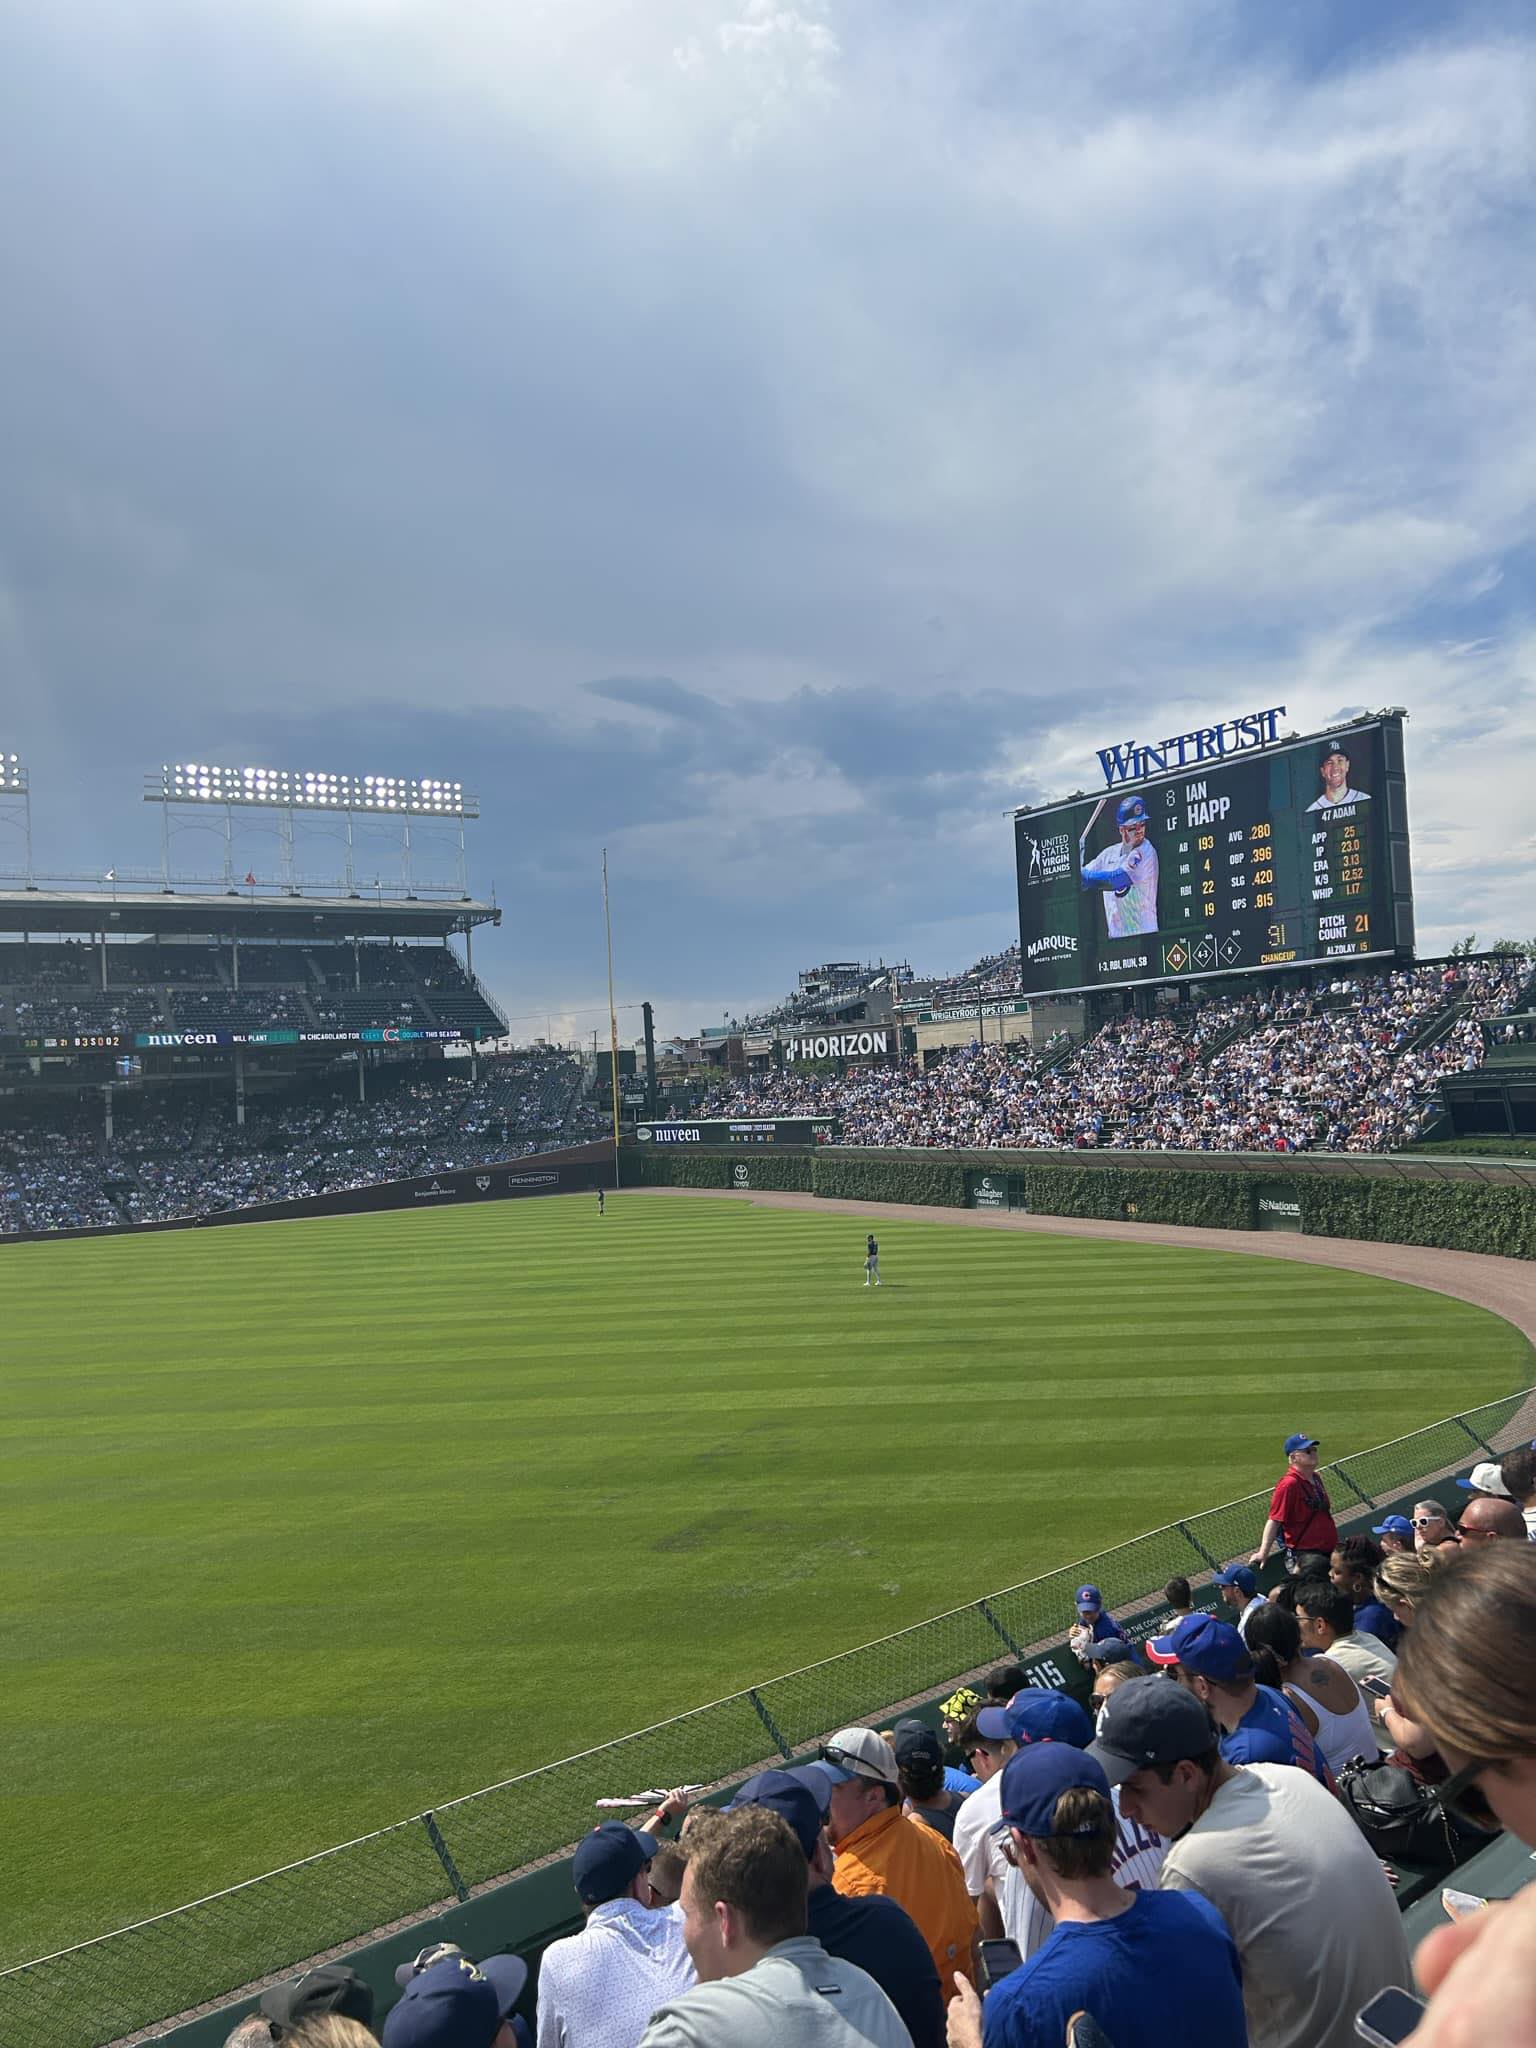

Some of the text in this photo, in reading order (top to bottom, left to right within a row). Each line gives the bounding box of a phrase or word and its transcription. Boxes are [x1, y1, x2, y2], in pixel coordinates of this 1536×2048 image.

[1096, 706, 1286, 785] WINTRUST
[1166, 789, 1176, 806] 8
[1186, 781, 1207, 802] IAN
[1187, 796, 1231, 828] HAPP
[1321, 805, 1356, 822] 47 ADAM
[1167, 817, 1178, 831] LF
[1228, 823, 1271, 843] AVG .280
[1312, 826, 1356, 845] APP 25
[1041, 834, 1069, 849] UNITED
[1179, 835, 1214, 853] AB 193
[1316, 839, 1360, 857] IP 23.0
[1041, 843, 1070, 858] STATES
[1229, 846, 1272, 865] OBP .396
[1042, 853, 1070, 868] VIRGIN
[1180, 858, 1210, 875] HR 4
[1313, 855, 1360, 872] ERA 3.13
[1043, 863, 1071, 876] ISLANDS
[1315, 867, 1363, 886] K/9 12.52
[1231, 869, 1273, 888] SLG .420
[1202, 880, 1215, 895] 22
[1312, 888, 1333, 900] WHIP
[1231, 892, 1273, 910] OPS .815
[1184, 902, 1215, 917] R 19
[1319, 914, 1345, 928] PITCH
[1354, 914, 1369, 933] 21
[1318, 926, 1348, 941] COUNT
[1027, 935, 1078, 958] MARQUEE
[1327, 943, 1356, 955] ALZOLAY
[1139, 956, 1147, 967] SB
[1261, 950, 1296, 964] CHANGEUP
[931, 1004, 1015, 1021] WRIGLEYROOFOPS.COM
[148, 1033, 217, 1045] nuveen
[248, 1034, 267, 1042] PLANT
[307, 1032, 347, 1041] CHICAGOLAND
[439, 1030, 460, 1038] SEASON
[802, 1031, 887, 1059] HORIZON
[656, 1128, 700, 1141] nuveen
[973, 1187, 1003, 1199] Gallagher
[1269, 1200, 1300, 1211] Nationa
